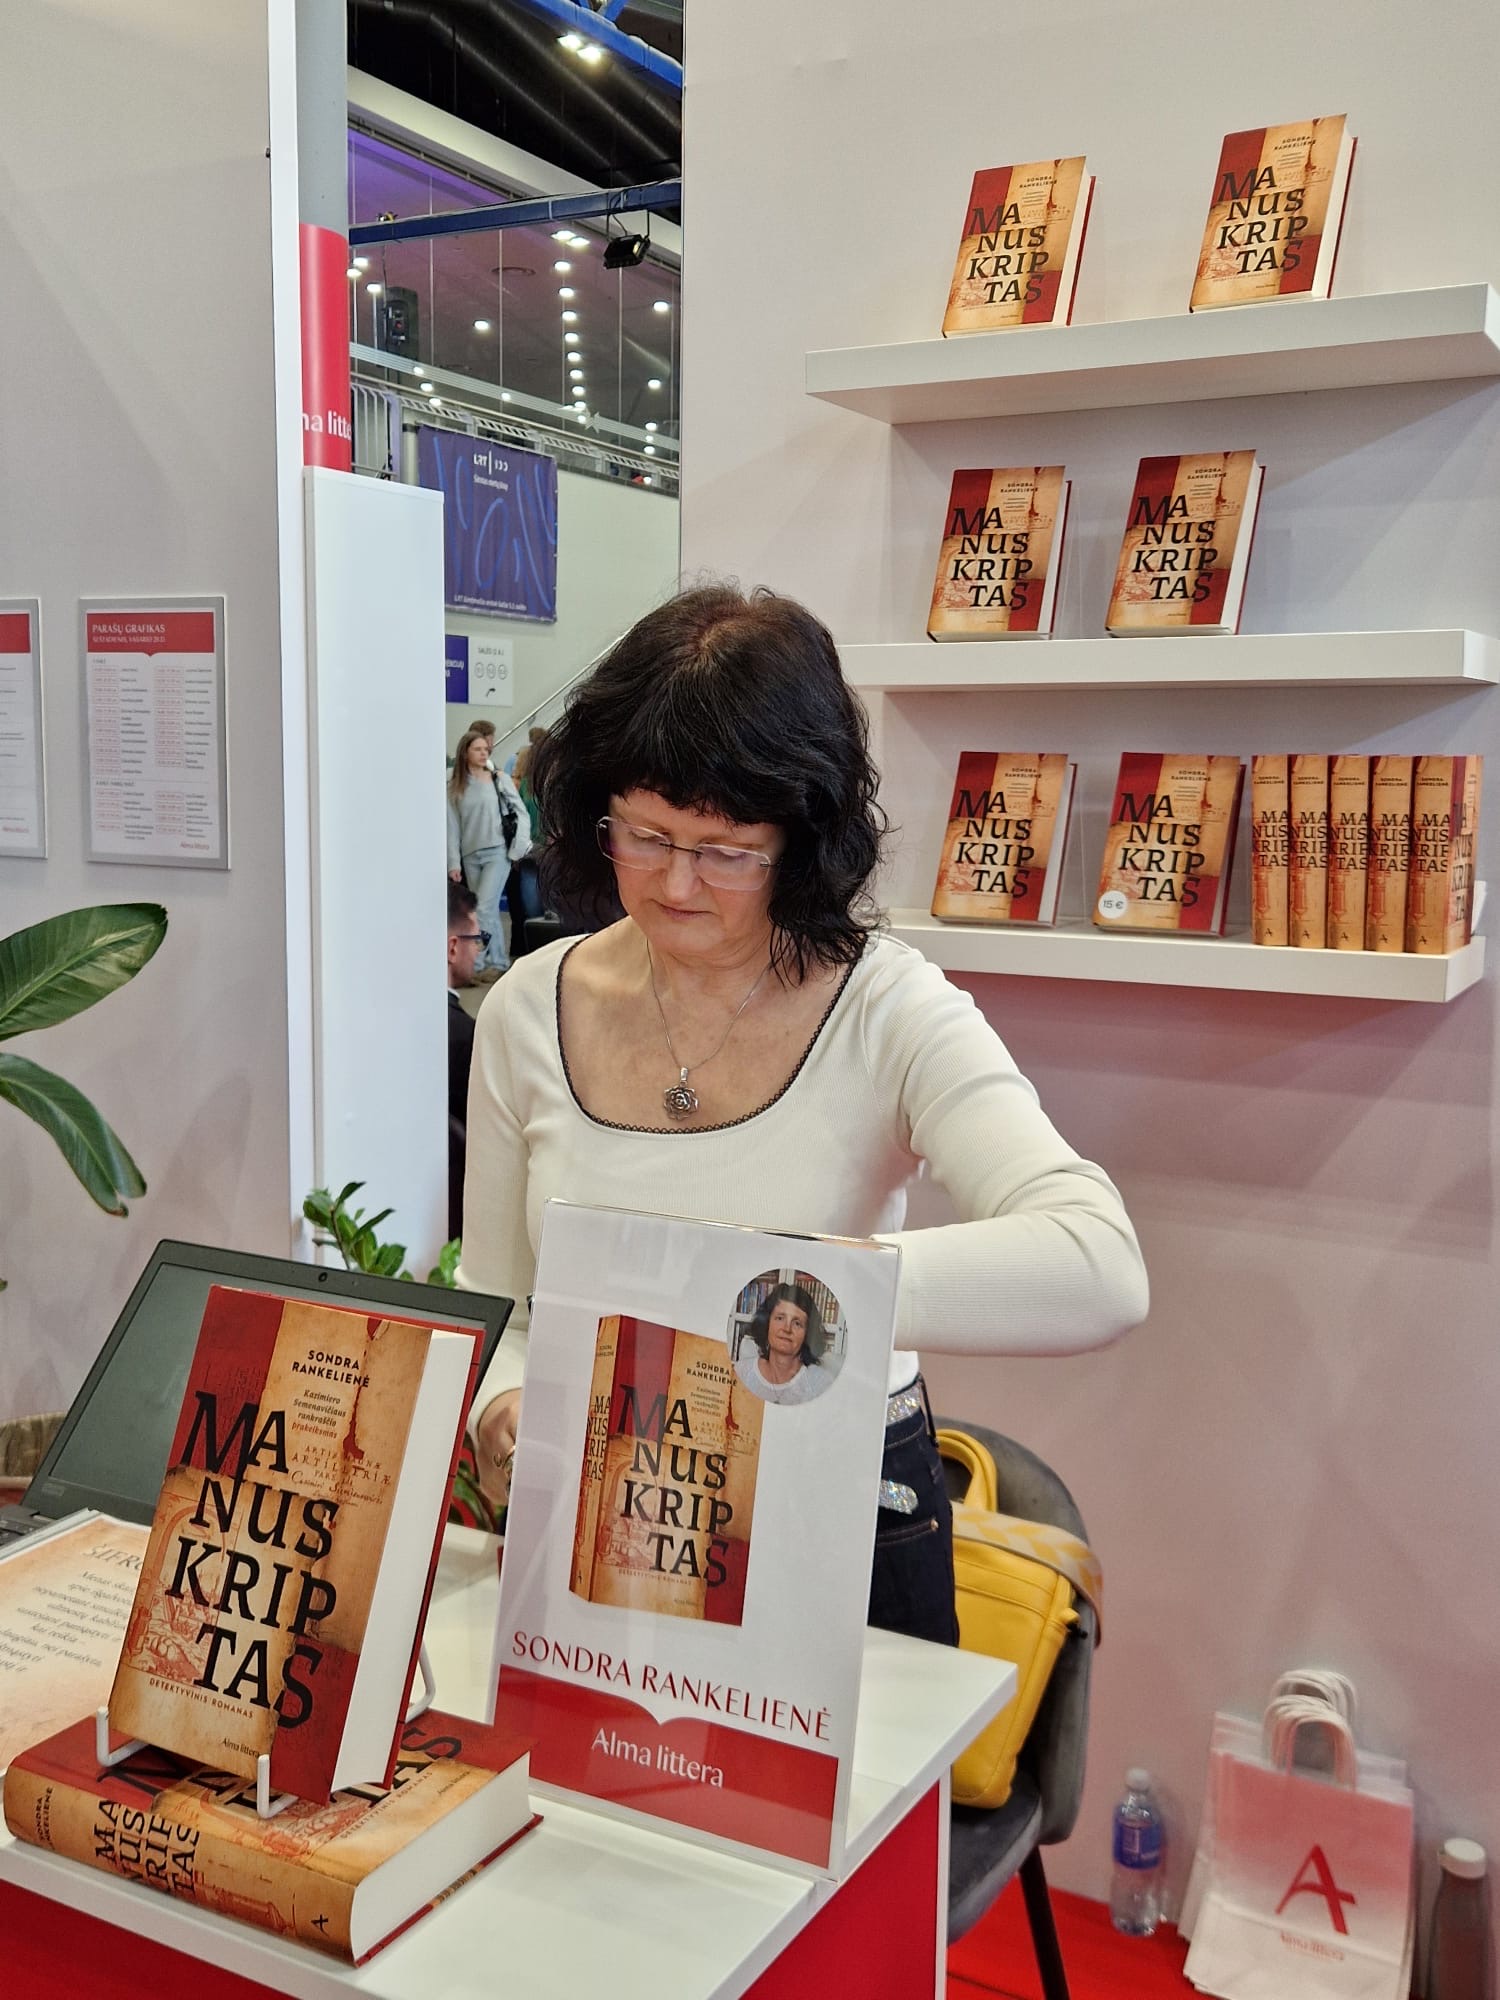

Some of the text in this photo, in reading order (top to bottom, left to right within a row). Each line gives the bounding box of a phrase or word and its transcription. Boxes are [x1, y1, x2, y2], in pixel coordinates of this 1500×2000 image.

[1219, 165, 1277, 204] MA
[1227, 188, 1305, 221] NUS
[970, 203, 1021, 236] MA
[1218, 216, 1309, 249] KRIP
[978, 226, 1047, 253] NUS
[969, 251, 1049, 280] KRIP
[1237, 240, 1303, 275] TAS
[986, 274, 1045, 304] TAS
[952, 506, 1004, 535] MA
[1135, 495, 1190, 525] MA
[960, 533, 1030, 555] NUS
[1143, 520, 1216, 545] NUS
[952, 558, 1033, 581] KRIP
[1133, 548, 1218, 573] KRIP
[970, 582, 1029, 611] TAS
[1152, 572, 1214, 603] TAS
[92, 622, 165, 635] PARAŠŲ GRAFIKAS
[957, 789, 1008, 818] MA
[1119, 793, 1175, 822] MA
[1261, 811, 1288, 823] MA
[1299, 811, 1327, 824] MA
[964, 818, 1032, 840] NUS
[1340, 812, 1367, 825] MA
[1381, 813, 1409, 826] MA
[1422, 813, 1450, 827] MA
[1128, 823, 1202, 846] NUS
[957, 842, 1035, 867] KRIP
[1120, 848, 1205, 875] KRIP
[1259, 854, 1288, 867] TAS
[1297, 855, 1328, 868] TAS
[1336, 857, 1367, 870] TAS
[1376, 859, 1408, 871] TAS
[1417, 859, 1448, 872] TAS
[973, 869, 1031, 899] TAS
[1138, 877, 1201, 907] TAS
[1103, 900, 1113, 908] 15
[1115, 900, 1124, 910] €
[292, 1361, 370, 1388] RANKELIENĖ
[308, 1350, 360, 1370] SONDRA
[696, 1361, 730, 1375] SONDRA
[304, 1389, 341, 1404] Kazimiero
[617, 1384, 692, 1441] MA
[180, 1391, 289, 1475] MA
[292, 1422, 338, 1439] prakeiksmas
[630, 1439, 727, 1490] NUS
[189, 1472, 339, 1560] NUS
[620, 1479, 733, 1535] KRIP
[647, 1533, 729, 1587] TAS
[165, 1536, 336, 1637] KRIP
[194, 1623, 323, 1728] TAS
[512, 1631, 832, 1741] SONDRA RANKELIENĖ
[149, 1677, 254, 1719] DETEKTYVINIS ROMANAS
[221, 1738, 240, 1752] Alma
[591, 1728, 724, 1788] Alma littera
[94, 1800, 121, 1864] MA
[171, 1824, 200, 1895] TAS
[1276, 1843, 1356, 1936] A
[311, 1913, 329, 1937] A
